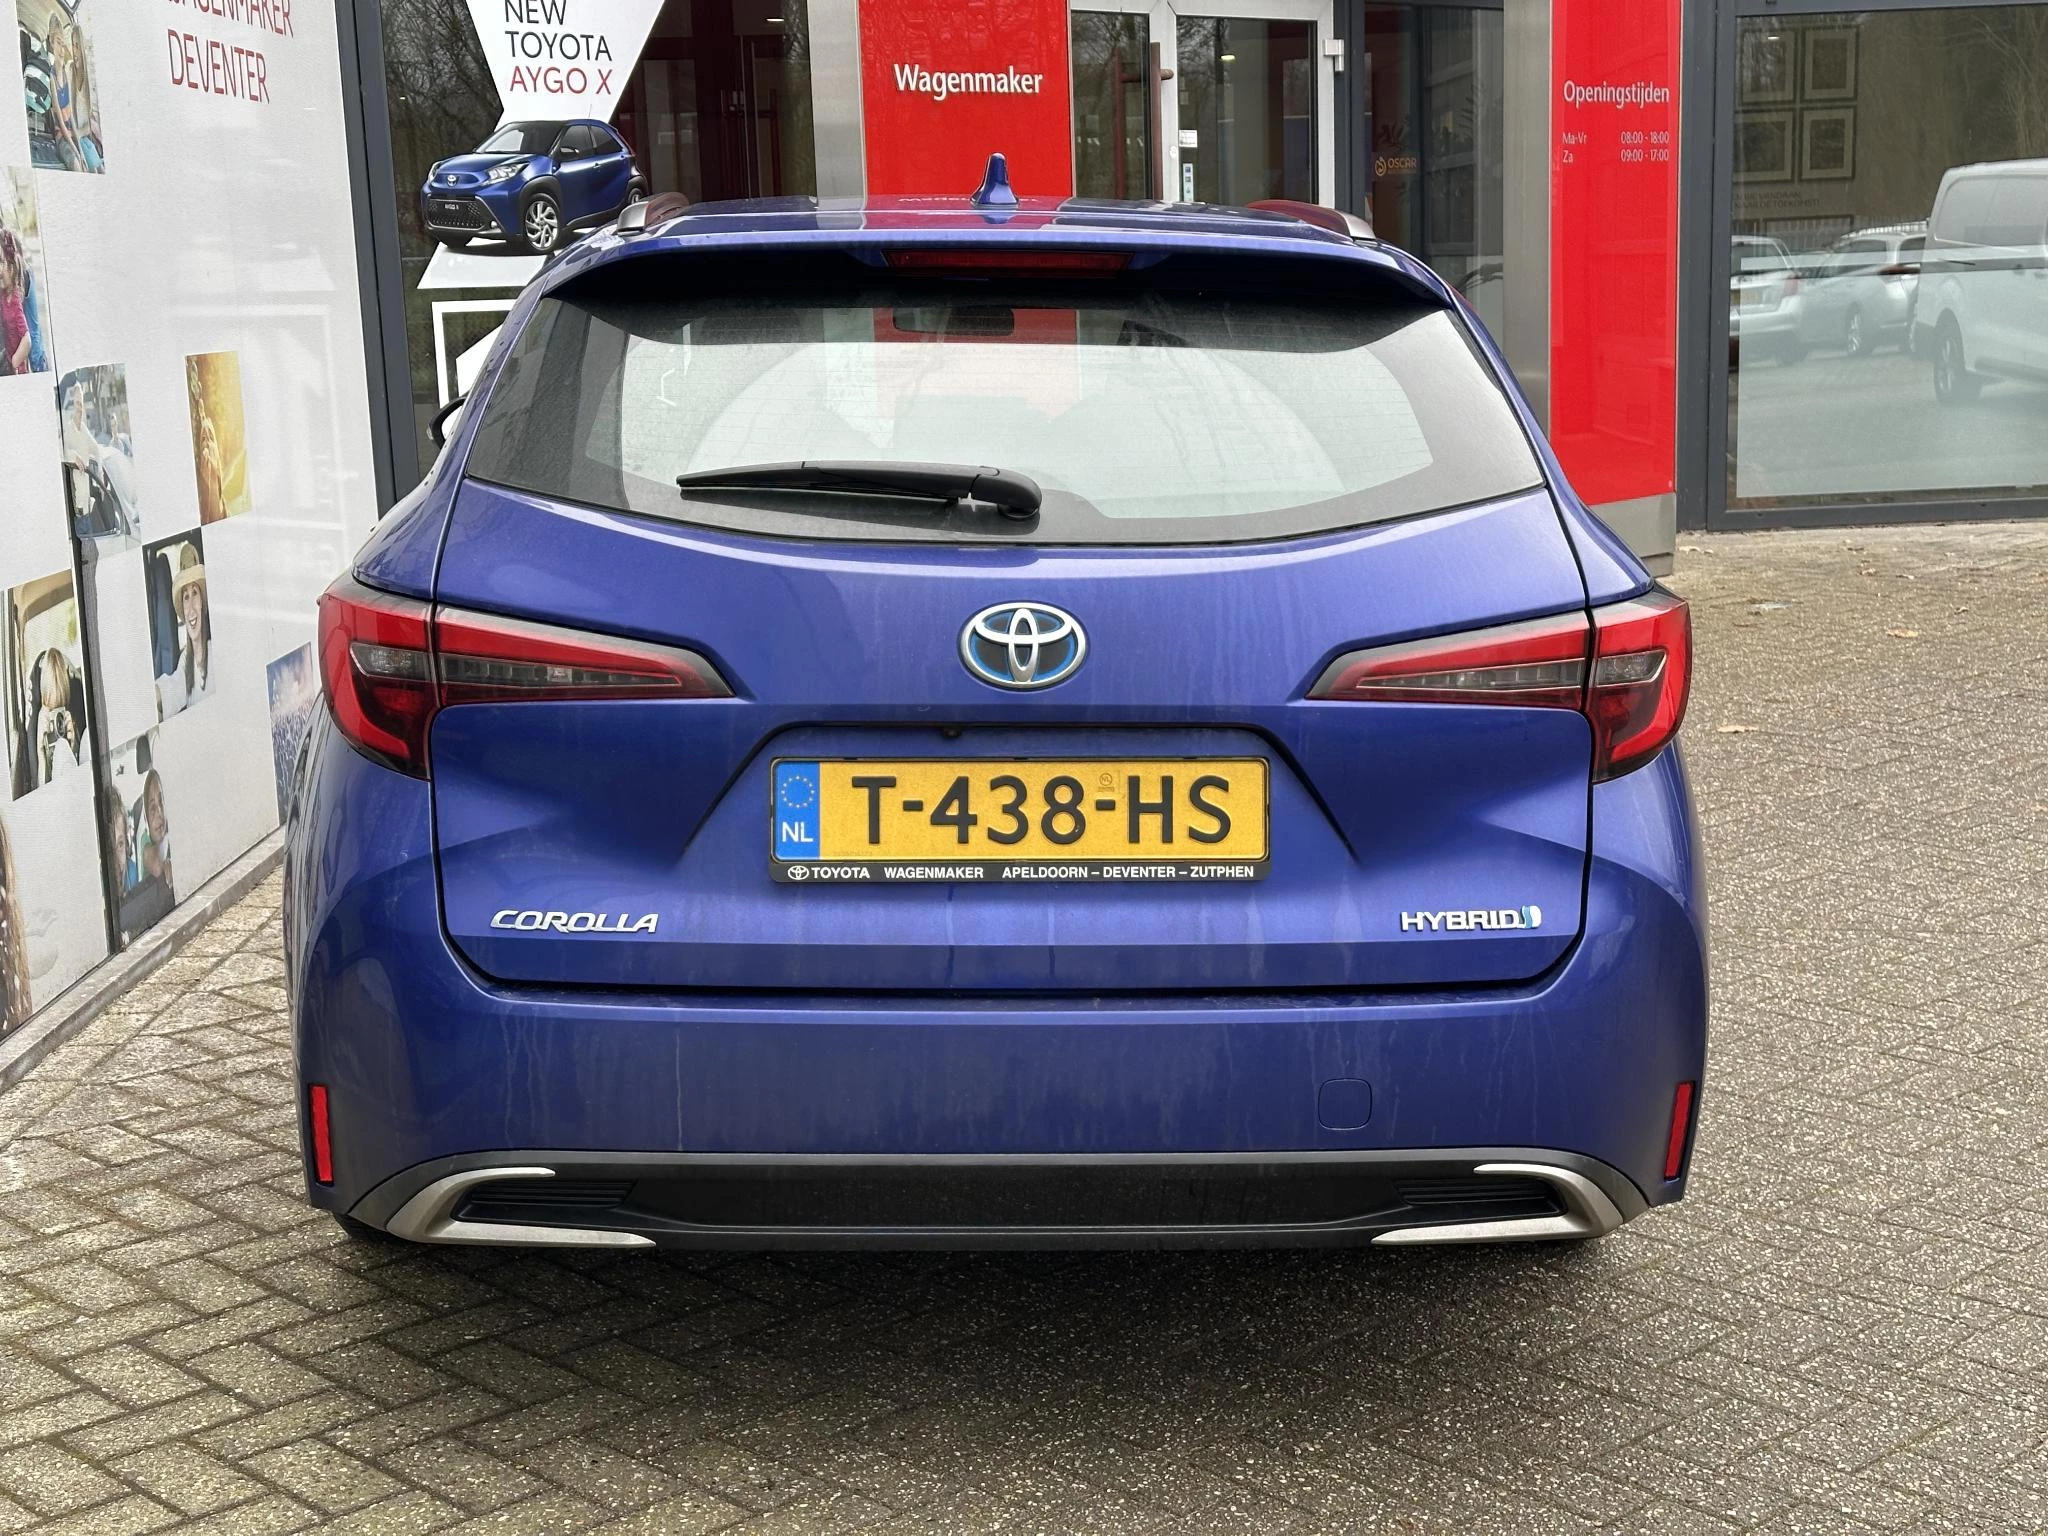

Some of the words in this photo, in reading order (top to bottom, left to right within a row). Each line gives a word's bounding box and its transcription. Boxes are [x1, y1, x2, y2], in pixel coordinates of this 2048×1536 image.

[504, 0, 567, 26] NEW
[504, 30, 613, 61] TOYOTA
[167, 28, 270, 105] DEVENTER
[509, 65, 588, 95] AYGO
[596, 68, 613, 95] X
[893, 63, 1043, 101] Wagenmaker
[1563, 80, 1670, 109] Openingstijden
[1562, 131, 1587, 144] Ma-Vr
[1620, 131, 1643, 144] 08:00
[1650, 131, 1670, 144] 18:00
[1387, 157, 1417, 169] OSCAR
[1562, 149, 1574, 163] Za
[1620, 148, 1643, 162] 09:00
[1650, 148, 1670, 162] 17:00
[851, 775, 1231, 845] T-438-HS
[781, 821, 814, 843] NL
[811, 866, 871, 879] TOYOTA
[884, 866, 984, 879] WAGENMAKER
[1001, 866, 1089, 879] APELDOORN
[1103, 866, 1176, 878] DEVENTER
[1190, 865, 1255, 878] ZUTPHEN
[489, 909, 659, 934] COROLLA
[1401, 909, 1521, 932] HYBRID
